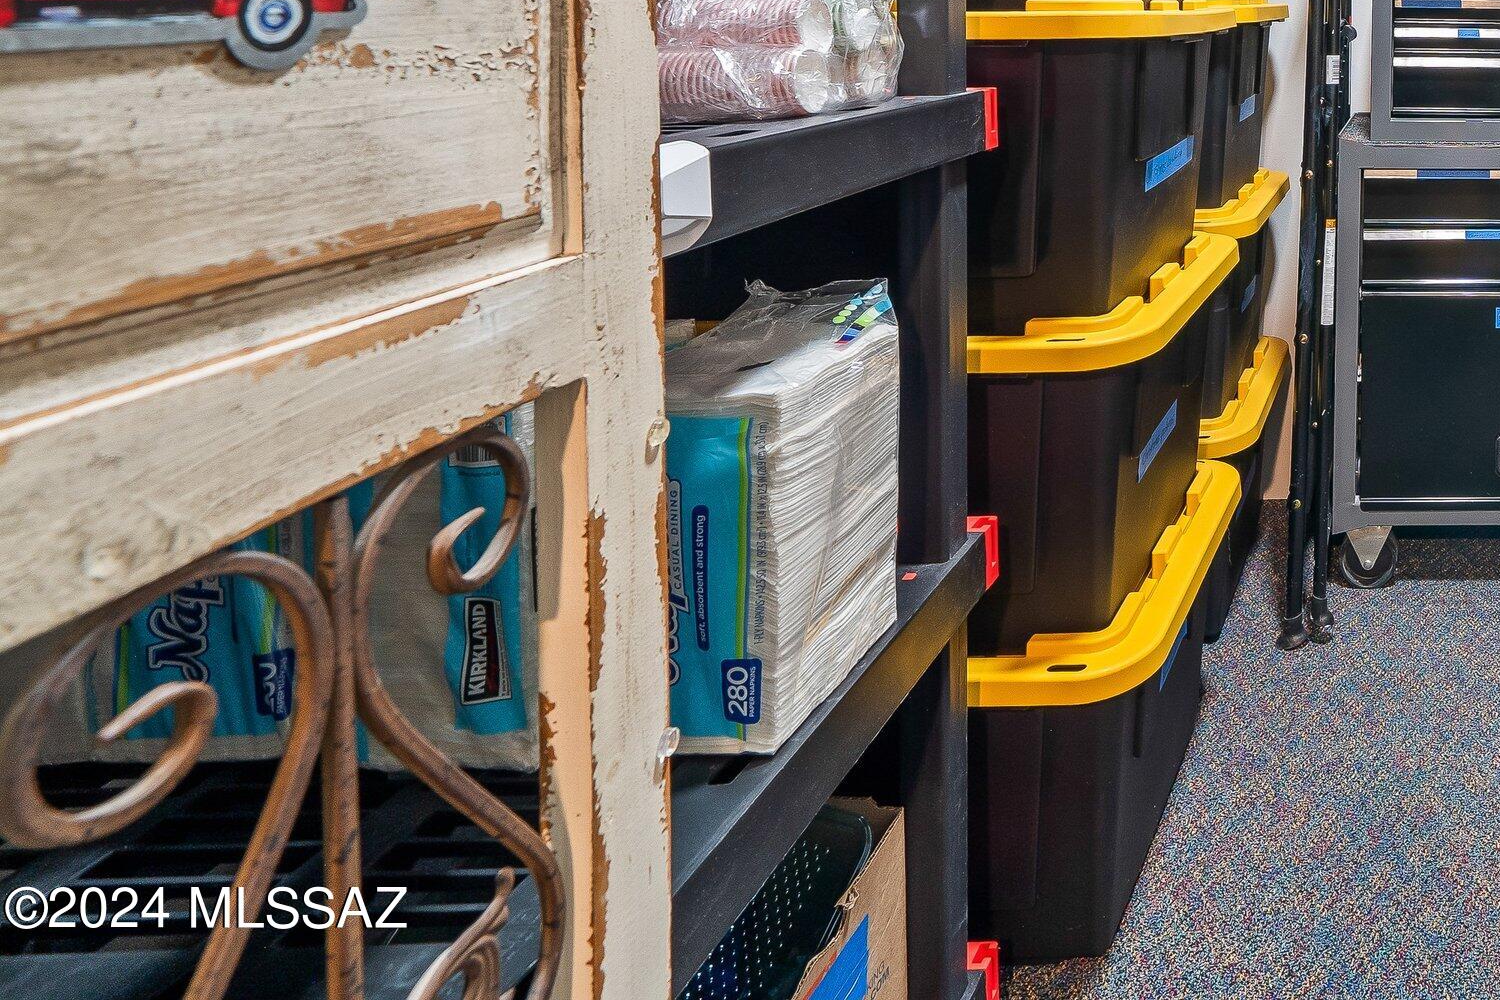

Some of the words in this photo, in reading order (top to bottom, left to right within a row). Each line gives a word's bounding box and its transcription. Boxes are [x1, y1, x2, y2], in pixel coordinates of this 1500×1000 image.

[669, 489, 679, 536] DINING
[696, 514, 707, 544] strong
[670, 537, 682, 590] CASUAL
[696, 545, 705, 565] and
[696, 567, 706, 620] absorbent
[468, 603, 487, 696] KIRKLAND
[700, 620, 708, 643] soft,
[726, 666, 749, 717] 280
